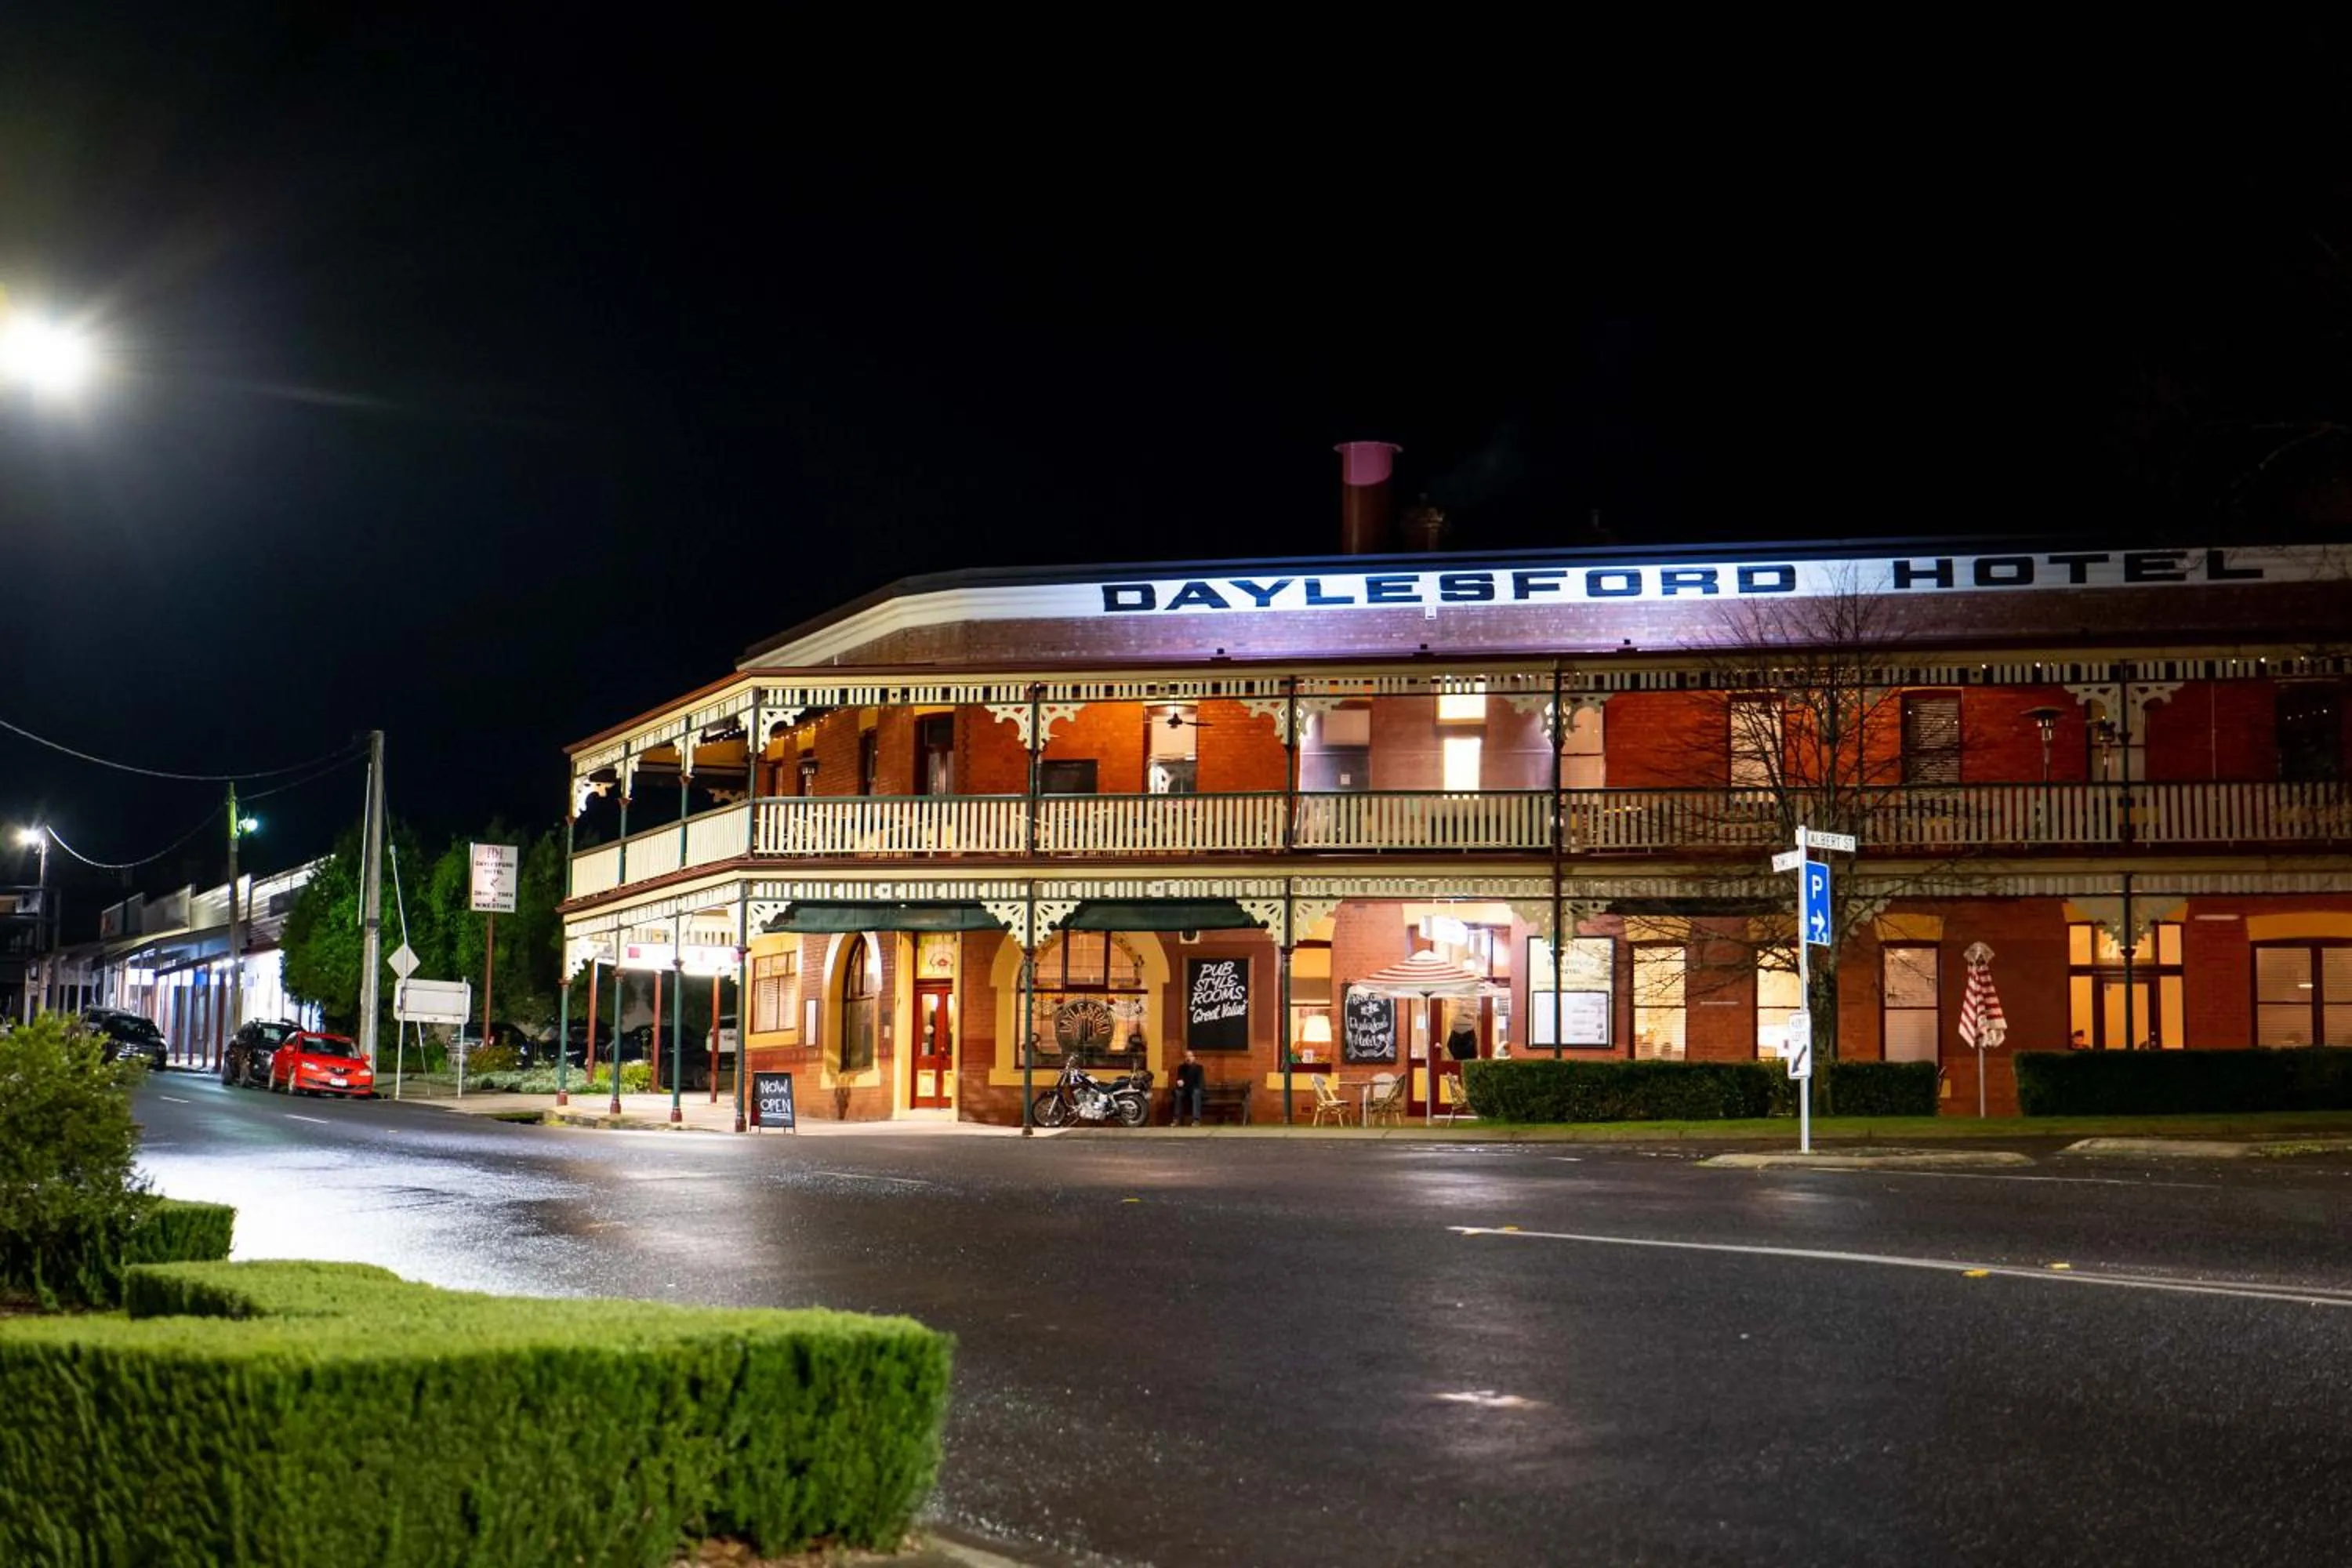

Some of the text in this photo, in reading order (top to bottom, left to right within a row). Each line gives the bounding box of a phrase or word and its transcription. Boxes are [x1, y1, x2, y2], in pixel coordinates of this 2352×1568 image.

[1101, 549, 2263, 612] DAYLESFORD HOTEL
[1811, 834, 1853, 849] ALBERT ST
[1812, 874, 1823, 900] P
[1200, 960, 1235, 980] PUB
[1193, 974, 1239, 992] STYLE
[1192, 985, 1246, 1005] ROOMS
[760, 1078, 788, 1094] NOW
[760, 1098, 791, 1112] OPEN
